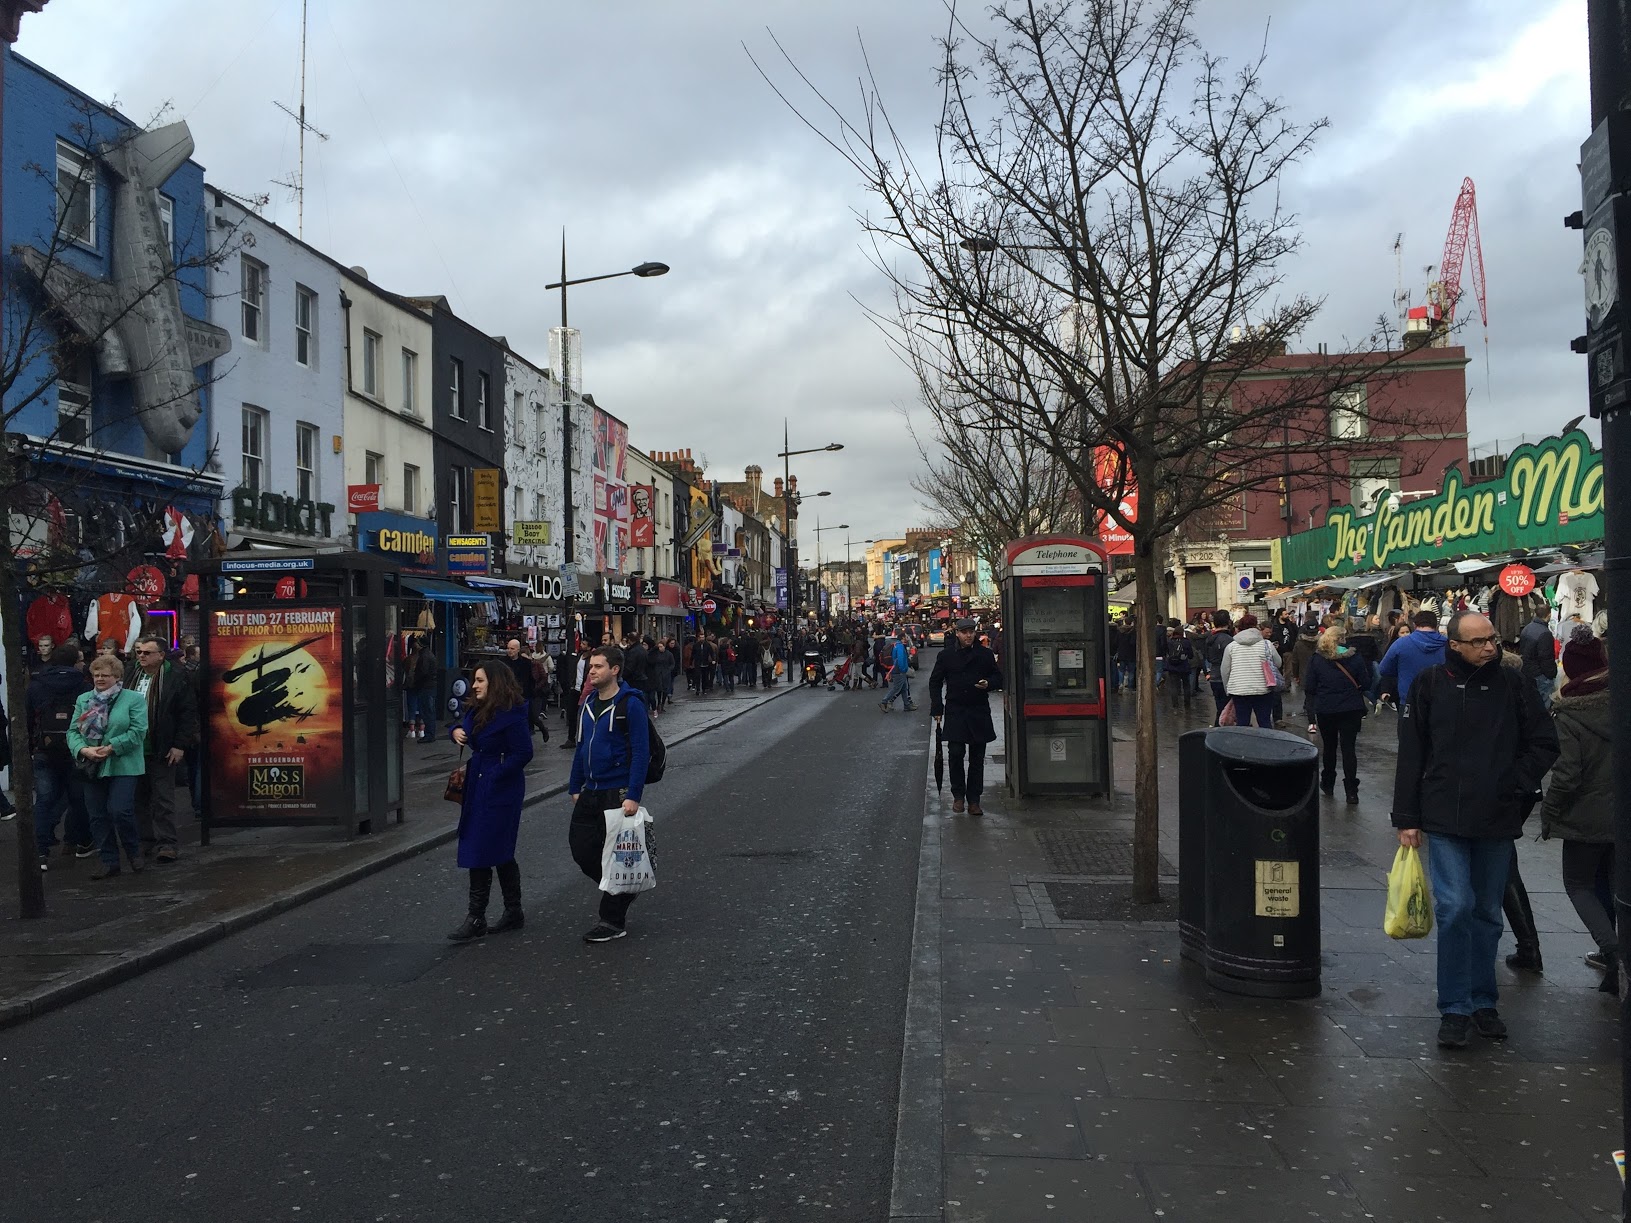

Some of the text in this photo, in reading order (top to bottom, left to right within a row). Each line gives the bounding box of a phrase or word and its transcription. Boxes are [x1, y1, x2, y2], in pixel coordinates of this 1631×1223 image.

[187, 330, 220, 349] ONDON
[1510, 443, 1605, 528] Ma
[1373, 477, 1494, 567] Camden
[380, 528, 434, 555] camden
[449, 538, 486, 546] NEWSAGENTS
[1327, 510, 1367, 569] The
[449, 552, 485, 562] camden
[1036, 550, 1078, 560] Telephone
[226, 561, 308, 570] infocus-media.org.uk
[134, 579, 158, 591] 0%
[1506, 575, 1529, 586] 50%
[281, 586, 295, 596] 70
[526, 574, 562, 600] ALDO
[578, 591, 594, 602] SHOP
[218, 612, 335, 626] MUST END 27 FEBRUARY
[217, 623, 334, 636] SEE IT PRIOR TO BROADWAY
[252, 781, 300, 798] Saigon
[616, 842, 642, 851] MARKET
